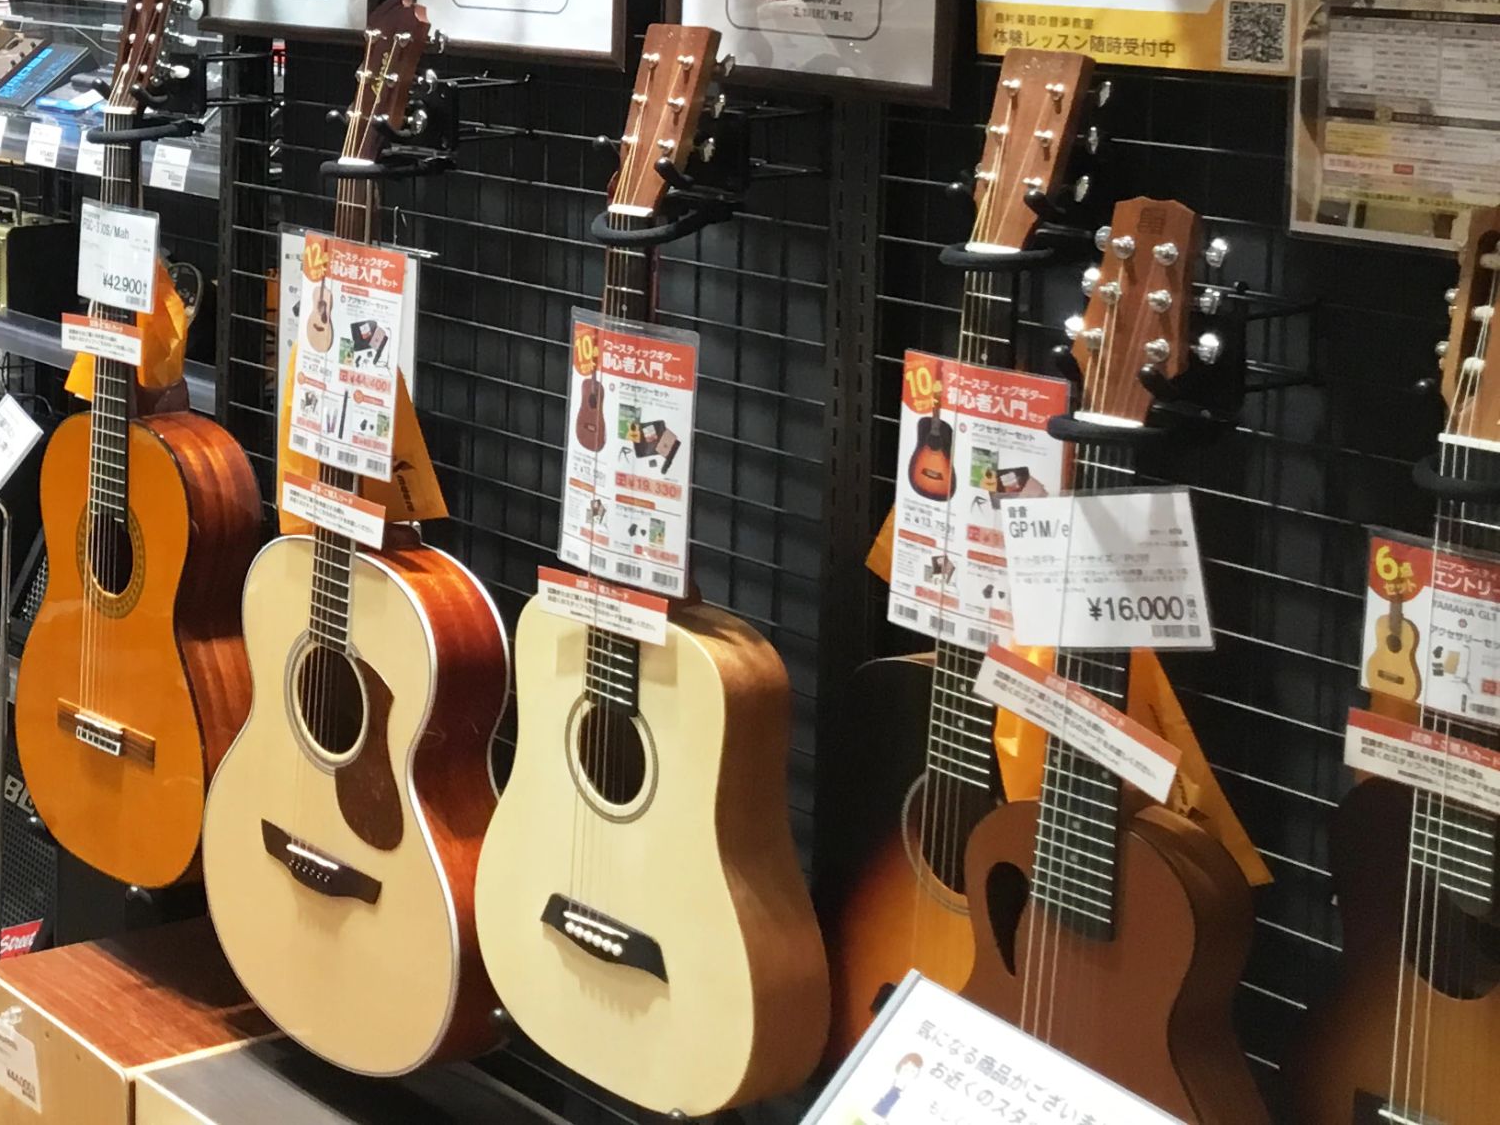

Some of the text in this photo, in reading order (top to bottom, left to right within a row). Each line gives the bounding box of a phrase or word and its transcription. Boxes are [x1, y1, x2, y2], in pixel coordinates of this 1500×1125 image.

[992, 29, 1177, 58] 体験レッスン随時受付中
[603, 339, 681, 362] アコースティックギター
[947, 372, 1050, 401] アコースティックギター
[946, 386, 1050, 425] 初心者入門セッ
[971, 421, 1036, 442] アクセサリーセット
[1087, 596, 1185, 622] ¥16,000
[929, 1061, 1036, 1125] お近くのスタ
